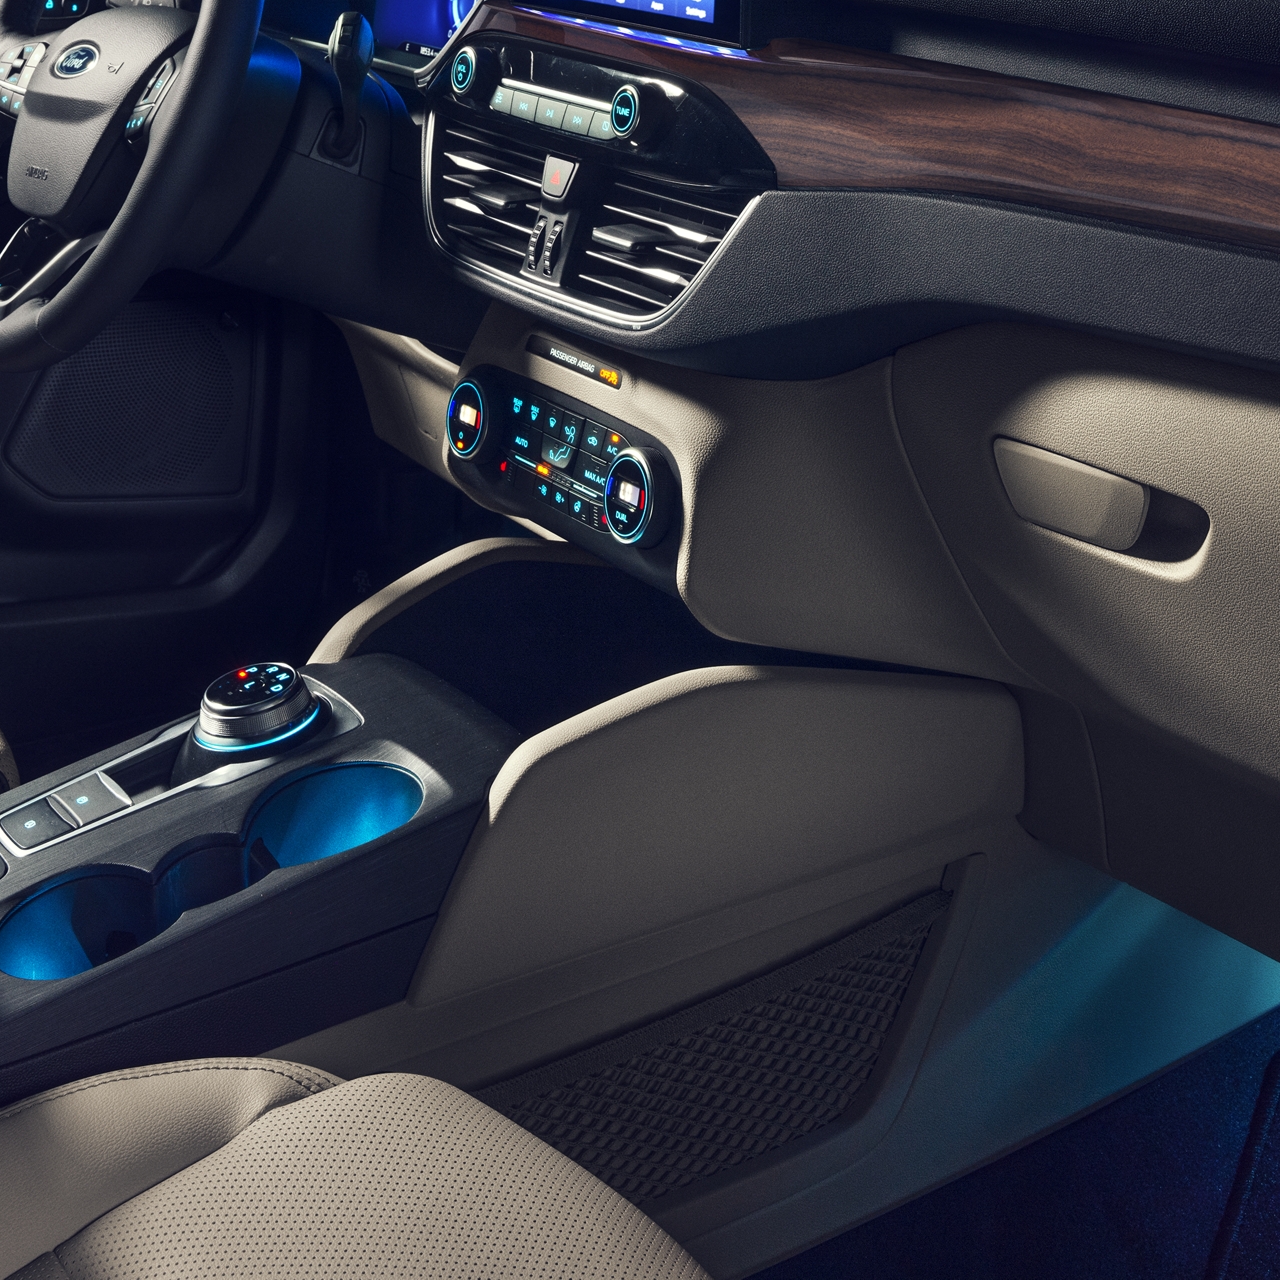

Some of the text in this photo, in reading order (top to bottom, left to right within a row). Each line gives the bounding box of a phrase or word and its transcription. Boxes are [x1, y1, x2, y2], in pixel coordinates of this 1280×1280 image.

[62, 50, 88, 70] Ford
[616, 105, 630, 116] TUNE
[25, 166, 49, 181] AIRBAG
[550, 348, 611, 379] PASSENGER AIRBAG OFF
[515, 436, 528, 448] AUTO
[607, 445, 618, 455] A/C
[584, 470, 605, 486] MAX A/C
[616, 511, 628, 522] DUAL
[266, 666, 279, 674] R
[244, 681, 256, 690] L
[270, 684, 283, 692] D
